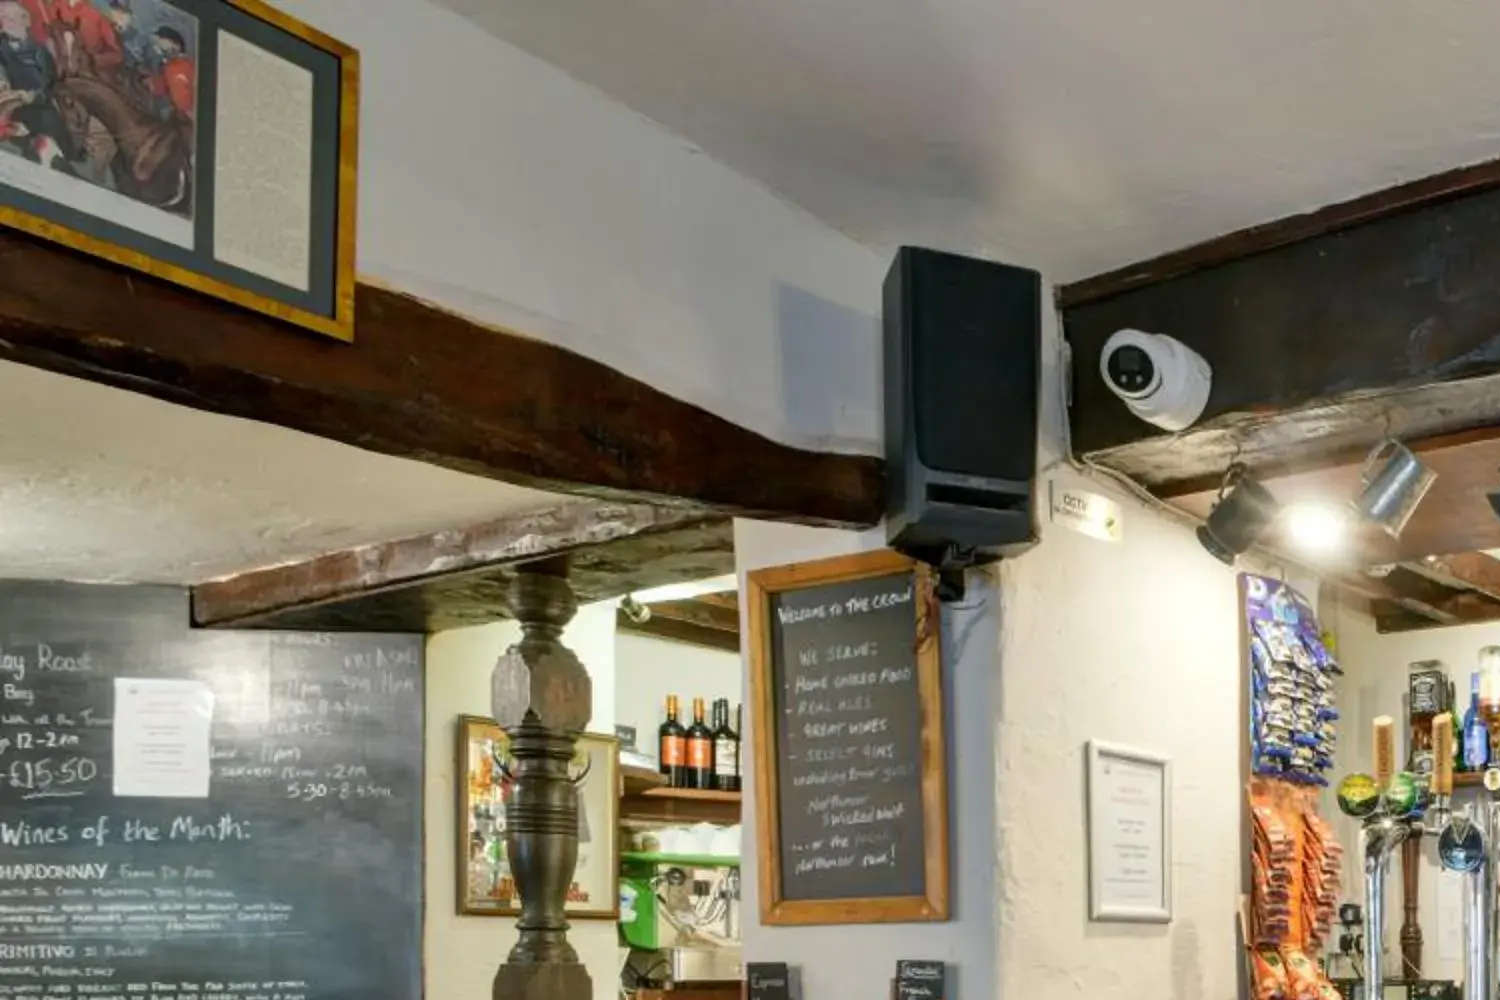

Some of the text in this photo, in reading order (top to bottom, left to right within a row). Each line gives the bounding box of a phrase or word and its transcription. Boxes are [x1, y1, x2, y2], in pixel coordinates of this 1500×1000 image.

[1, 820, 69, 847] Wines
[81, 816, 110, 847] of
[123, 818, 161, 842] the
